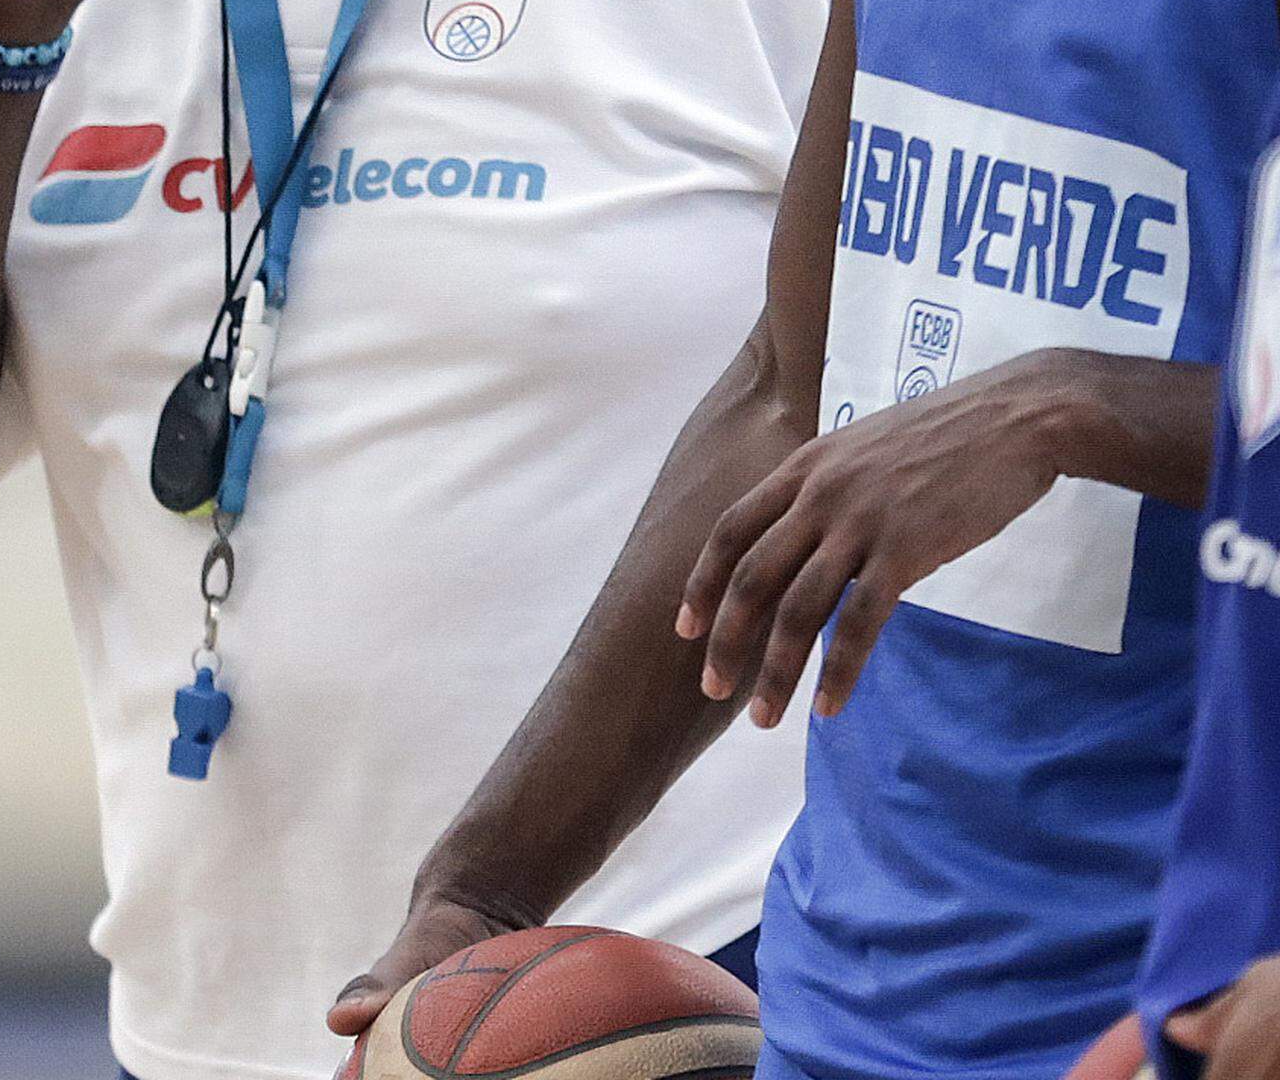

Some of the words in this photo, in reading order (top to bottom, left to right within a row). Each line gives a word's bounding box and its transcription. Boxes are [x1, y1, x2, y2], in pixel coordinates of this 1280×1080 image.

[163, 147, 547, 214] CVelecom
[937, 148, 1177, 327] VERDE
[909, 310, 954, 349] FCBB
